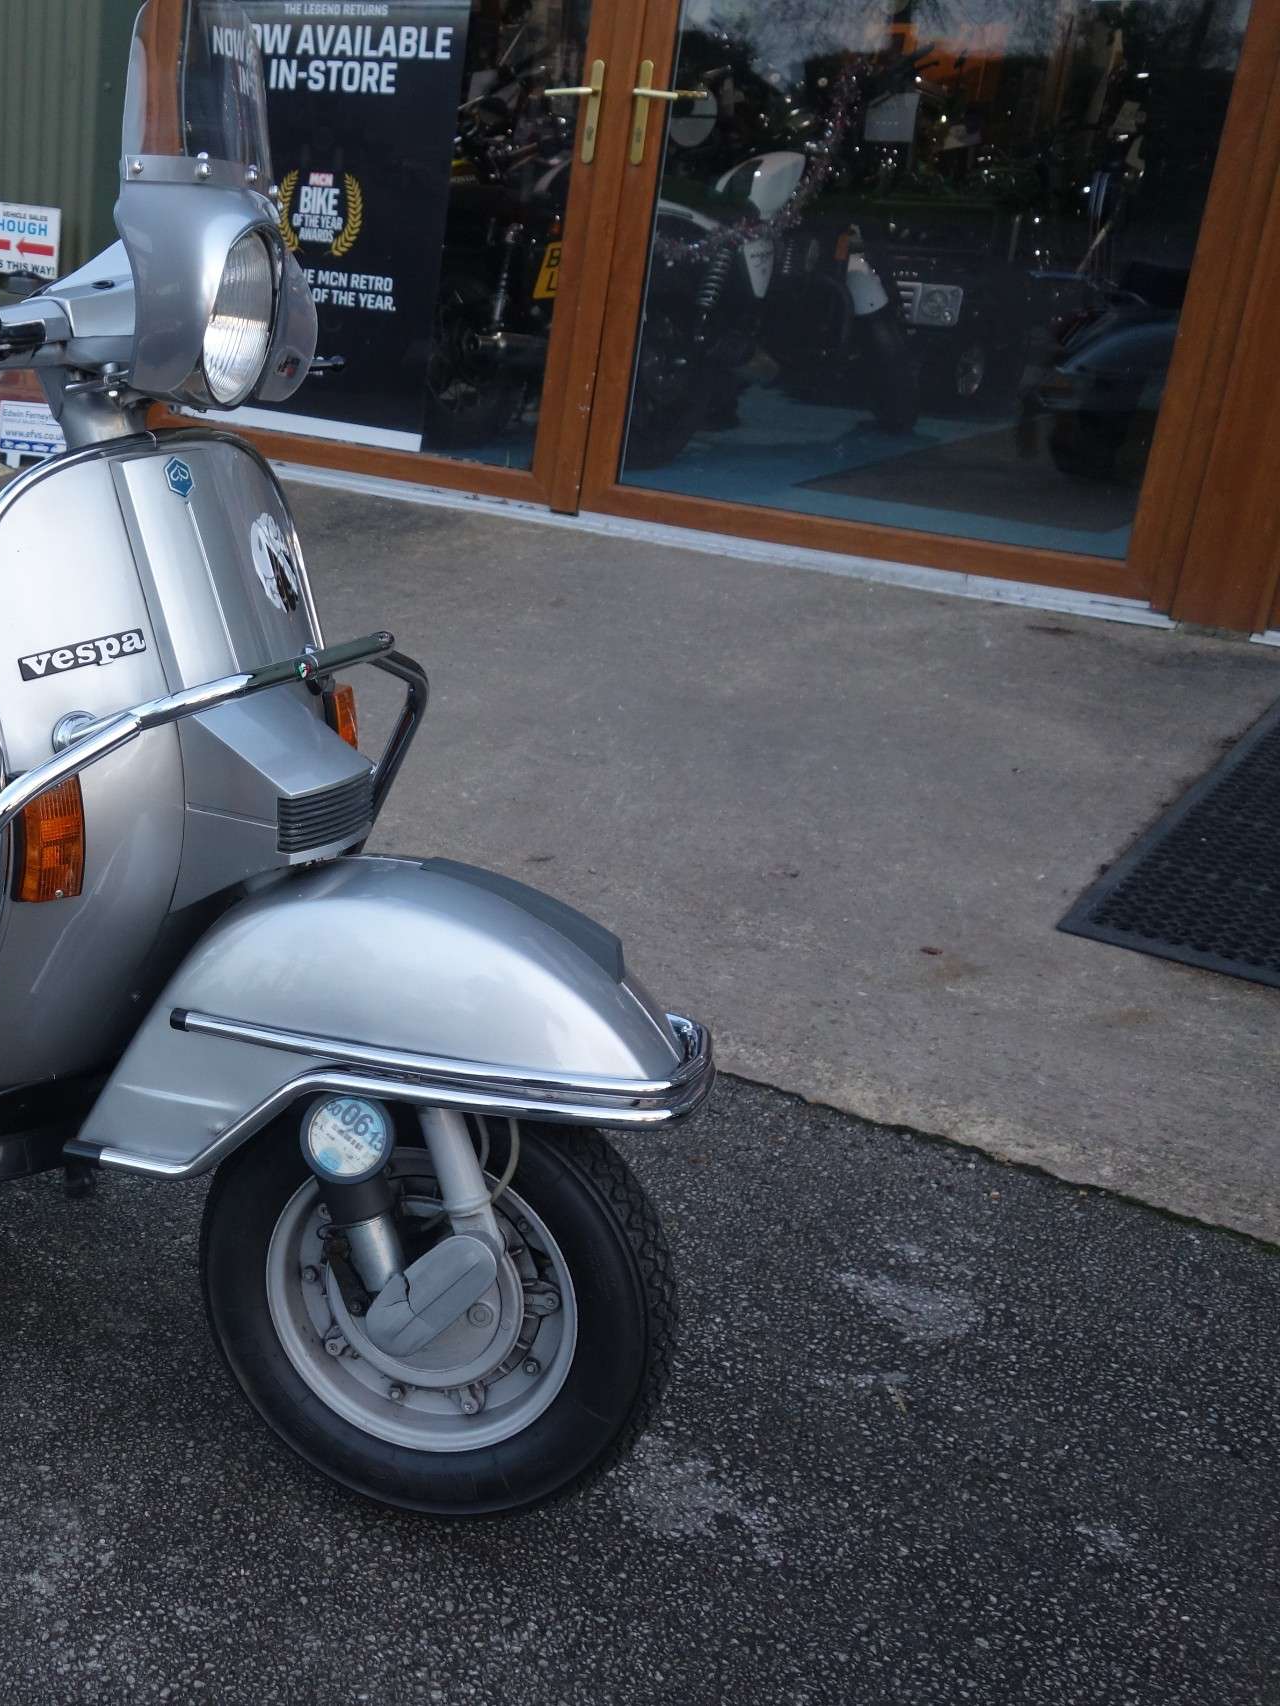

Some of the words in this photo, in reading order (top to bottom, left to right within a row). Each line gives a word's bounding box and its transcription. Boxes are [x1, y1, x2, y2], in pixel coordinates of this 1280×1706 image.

[284, 3, 301, 15] THE
[303, 4, 341, 15] LEGEND
[343, 4, 389, 16] RETURNS
[296, 24, 454, 60] AVAILABLE
[269, 58, 398, 94] IN-STORE
[299, 185, 340, 216] BIKE
[292, 213, 304, 227] OF
[304, 214, 320, 228] THE
[320, 215, 343, 230] YEAR
[298, 227, 334, 242] AWARDS
[6, 260, 29, 271] THIS
[31, 264, 55, 276] WAY!
[317, 269, 348, 288] MCN
[350, 273, 394, 293] RETRO
[312, 287, 330, 304] OF
[331, 289, 357, 307] THE
[358, 292, 397, 312] YEAR.
[21, 631, 146, 676] vespa
[341, 1103, 373, 1136] 06
